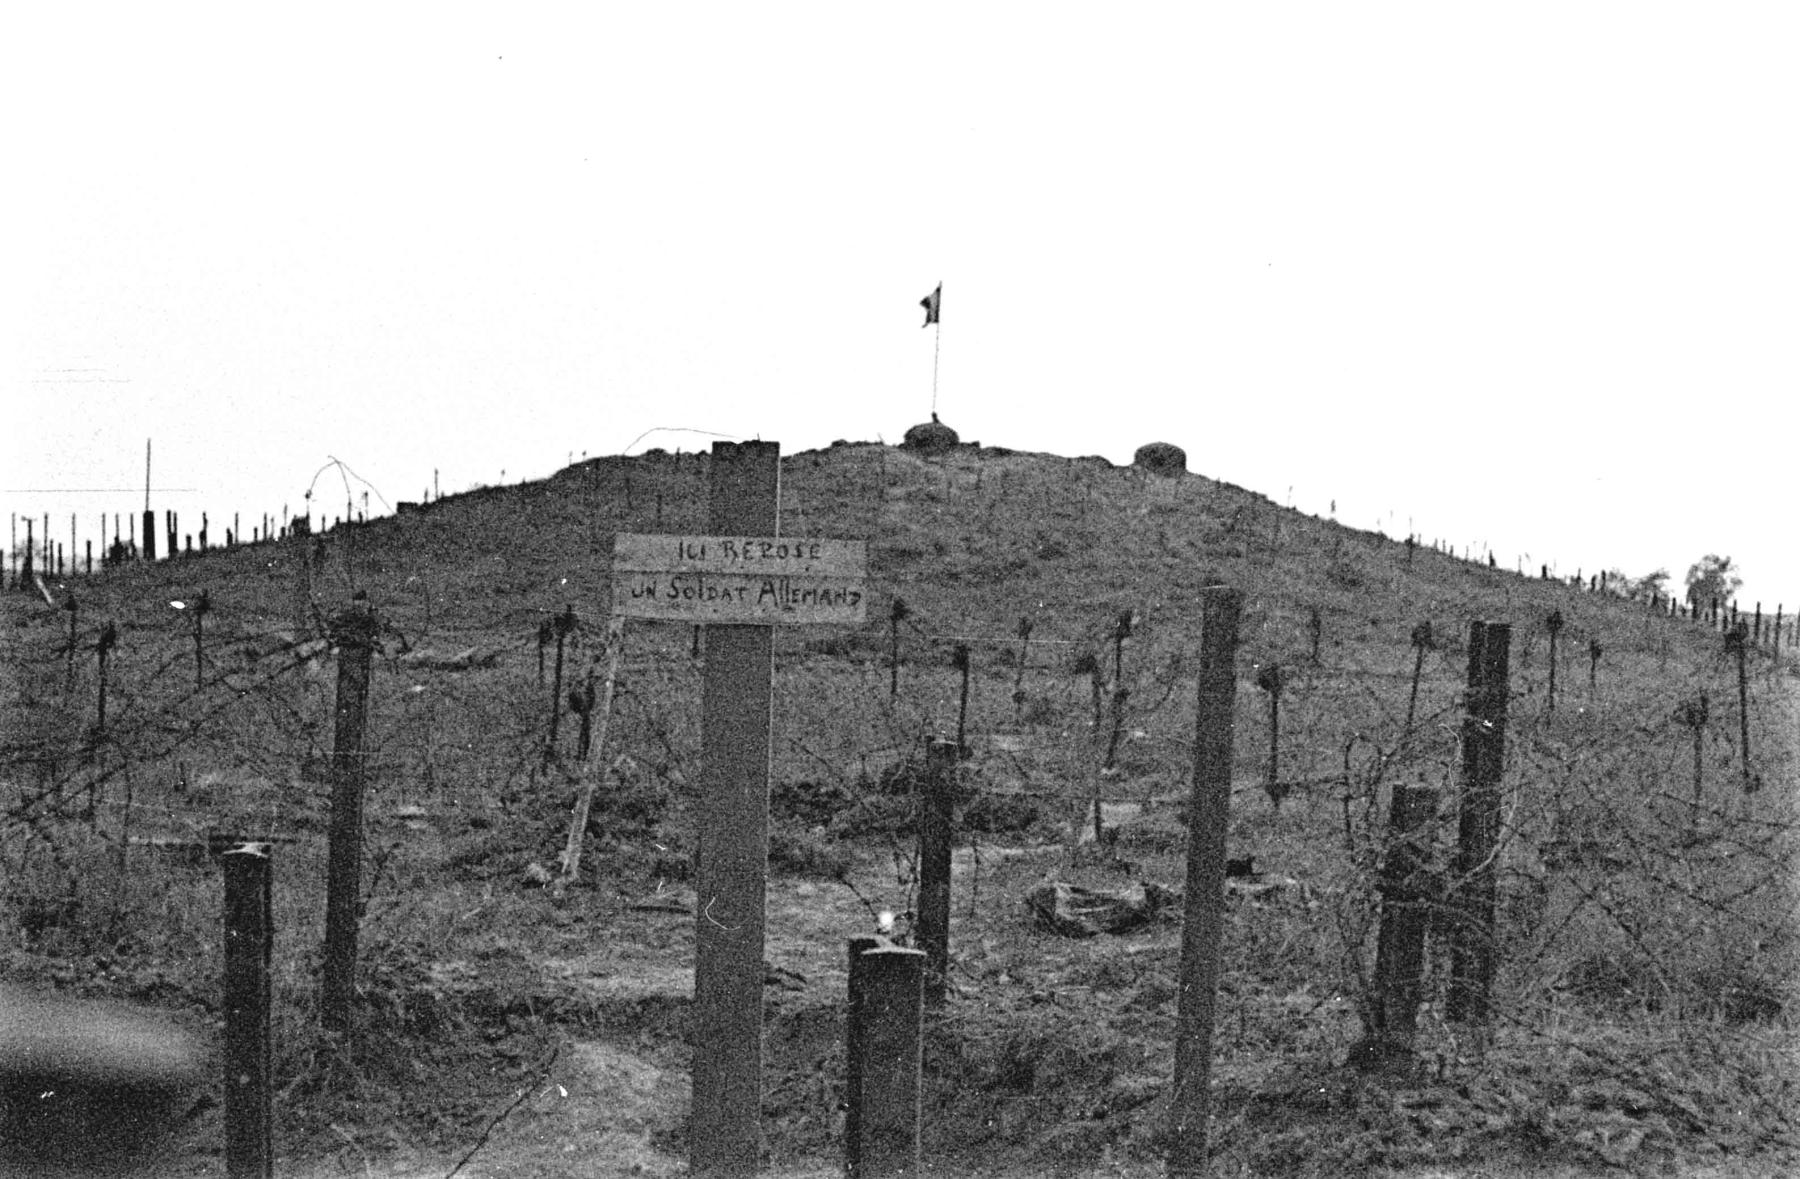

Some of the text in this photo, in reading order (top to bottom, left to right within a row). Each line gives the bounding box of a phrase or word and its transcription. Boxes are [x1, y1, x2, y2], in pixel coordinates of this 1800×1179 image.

[678, 540, 821, 564] ICI REPOSE
[631, 580, 658, 600] UN
